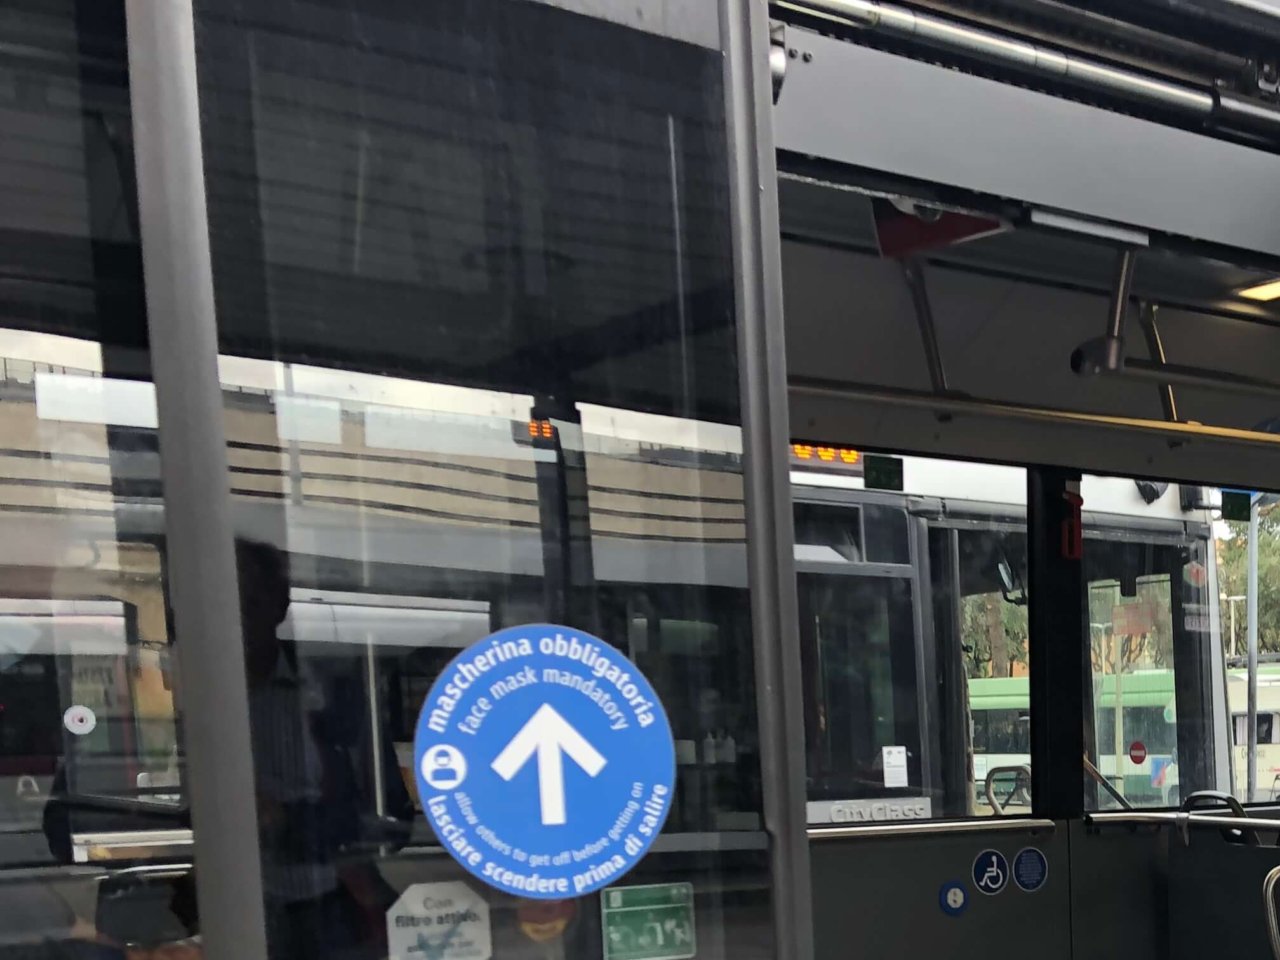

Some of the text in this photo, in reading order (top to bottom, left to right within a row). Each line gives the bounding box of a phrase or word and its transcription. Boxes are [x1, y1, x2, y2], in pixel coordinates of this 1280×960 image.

[427, 634, 655, 733] mascherina obbligatoria
[458, 666, 629, 735] face mask mandatory
[428, 784, 668, 893] lasciare scendere prima di salire
